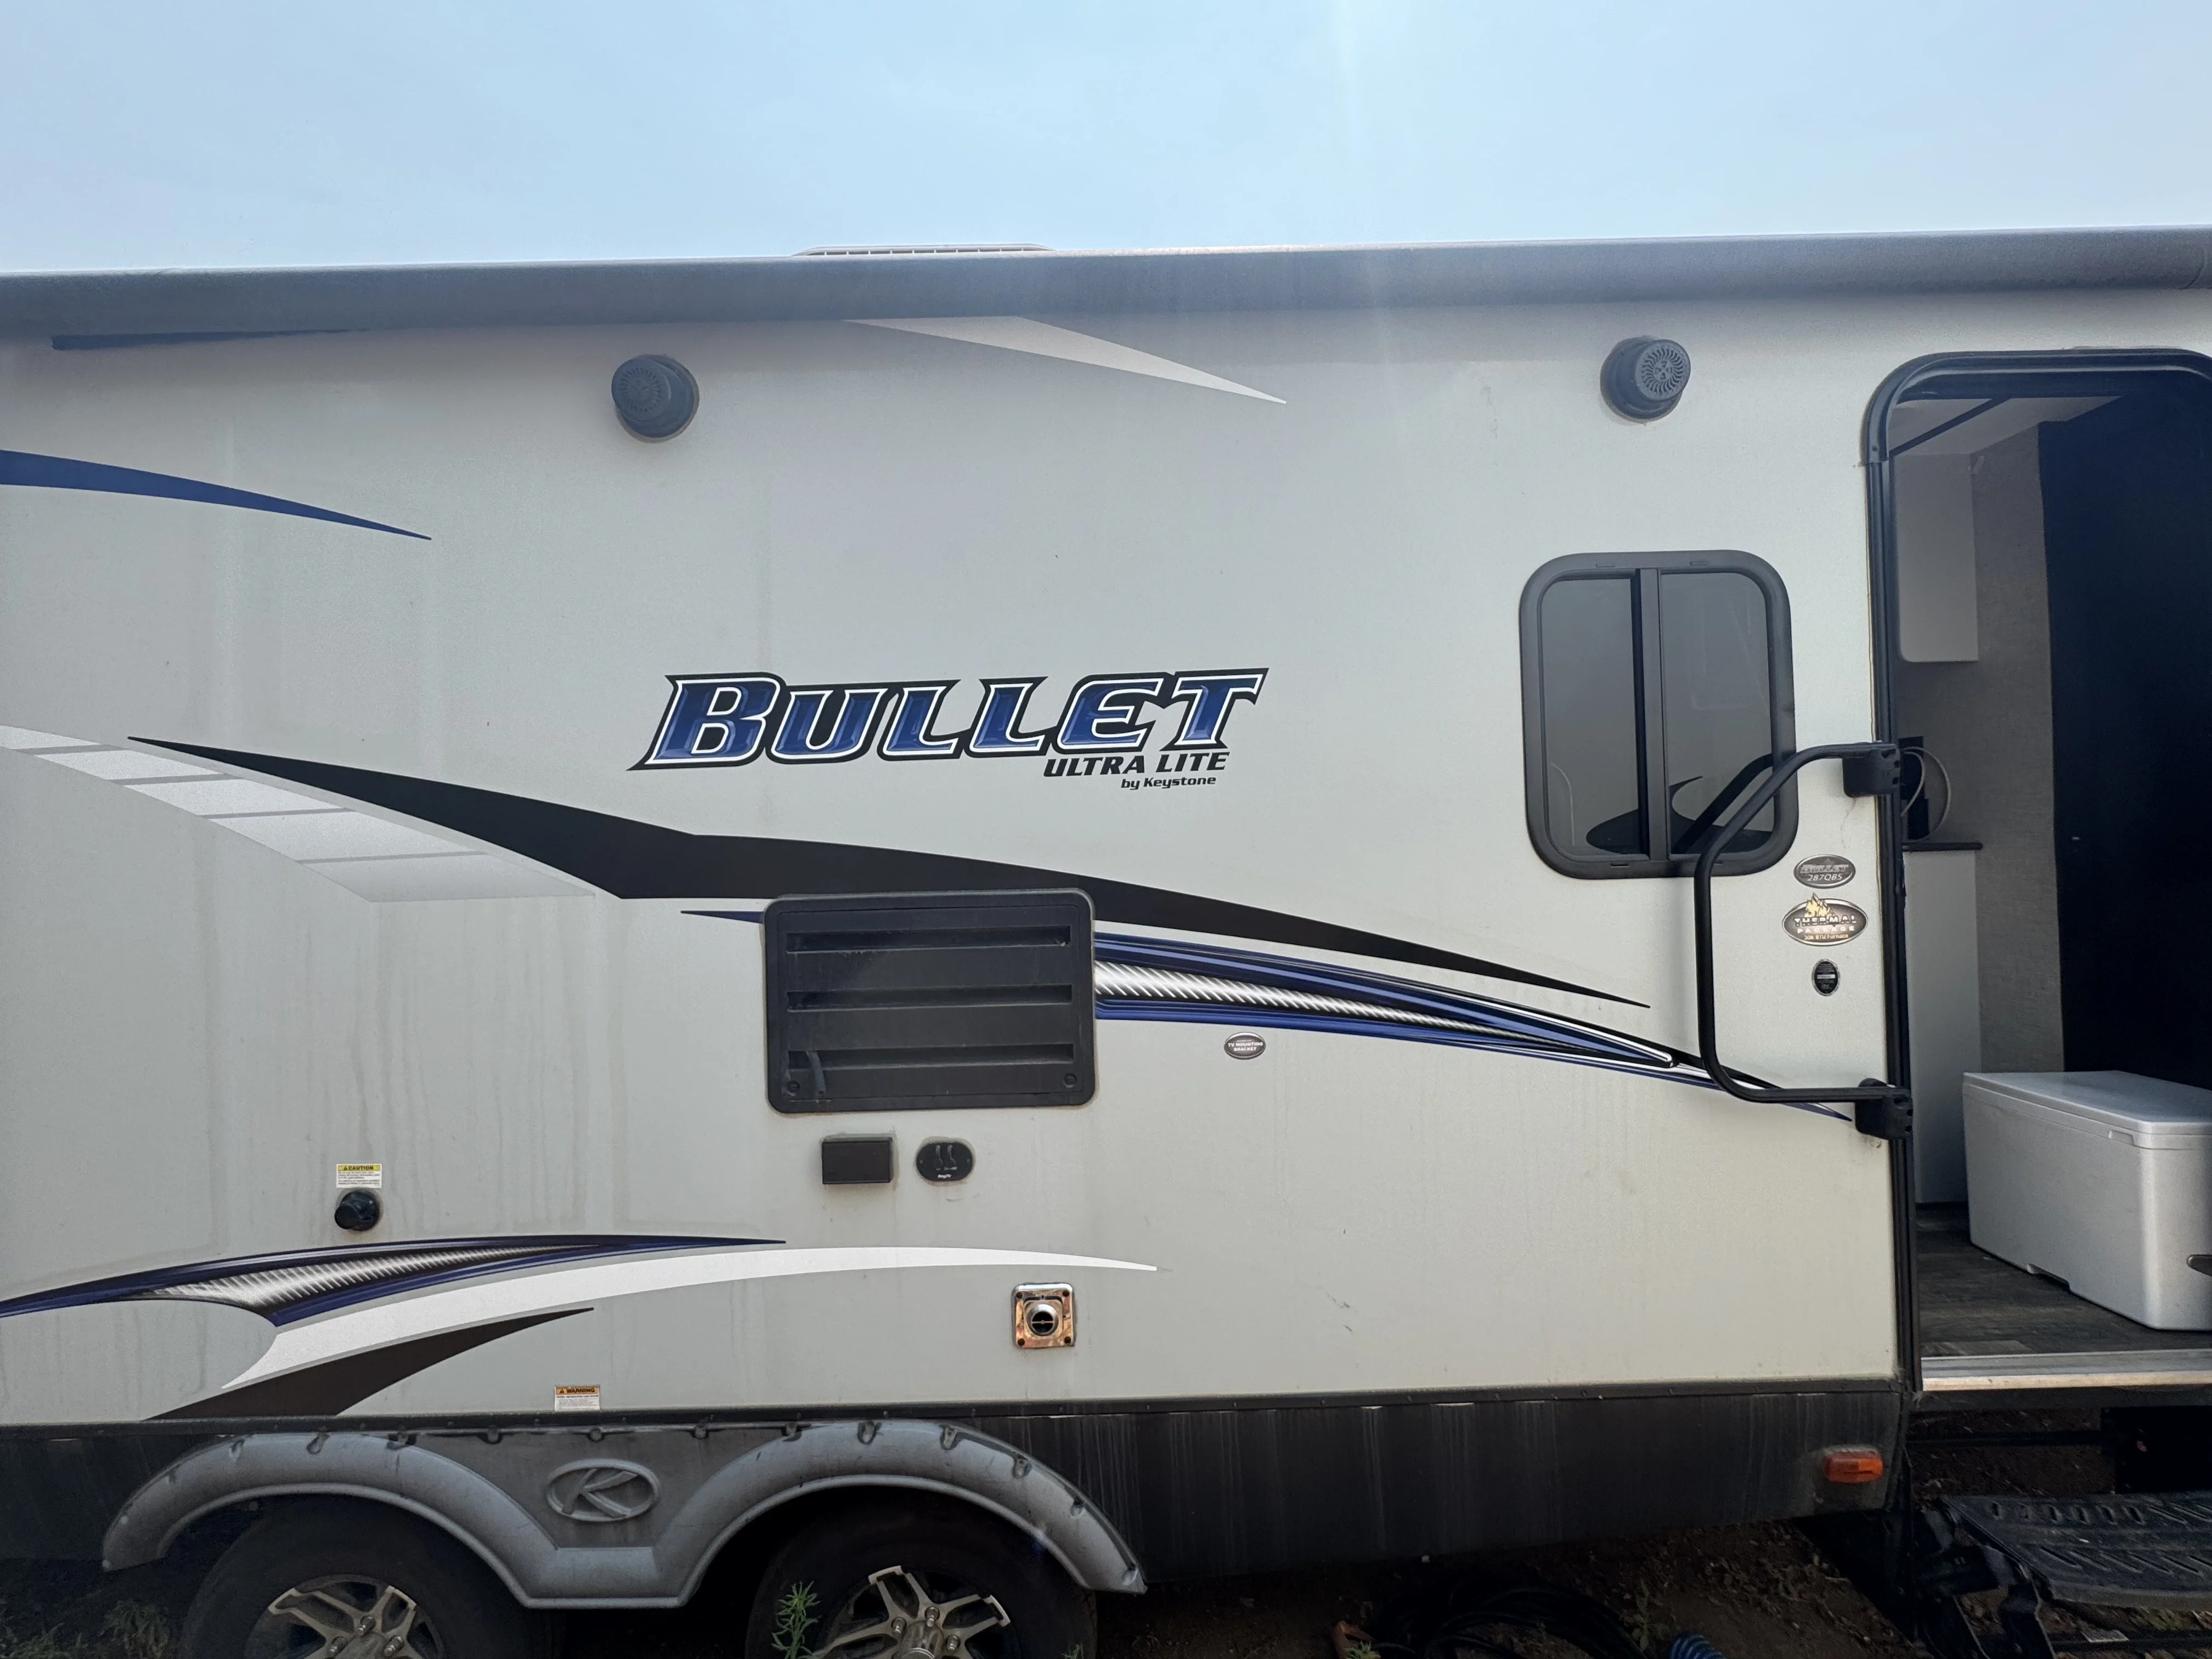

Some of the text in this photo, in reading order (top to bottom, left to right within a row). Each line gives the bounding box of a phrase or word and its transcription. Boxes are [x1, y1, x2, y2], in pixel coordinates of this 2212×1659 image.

[628, 668, 1269, 770] BULLET
[1043, 752, 1230, 777] ULTRA LITE
[1121, 777, 1216, 790] by Keystone
[1807, 873, 1843, 882] 287QBS
[1793, 915, 1857, 927] THERMAL
[1797, 926, 1855, 934] PACKAGE
